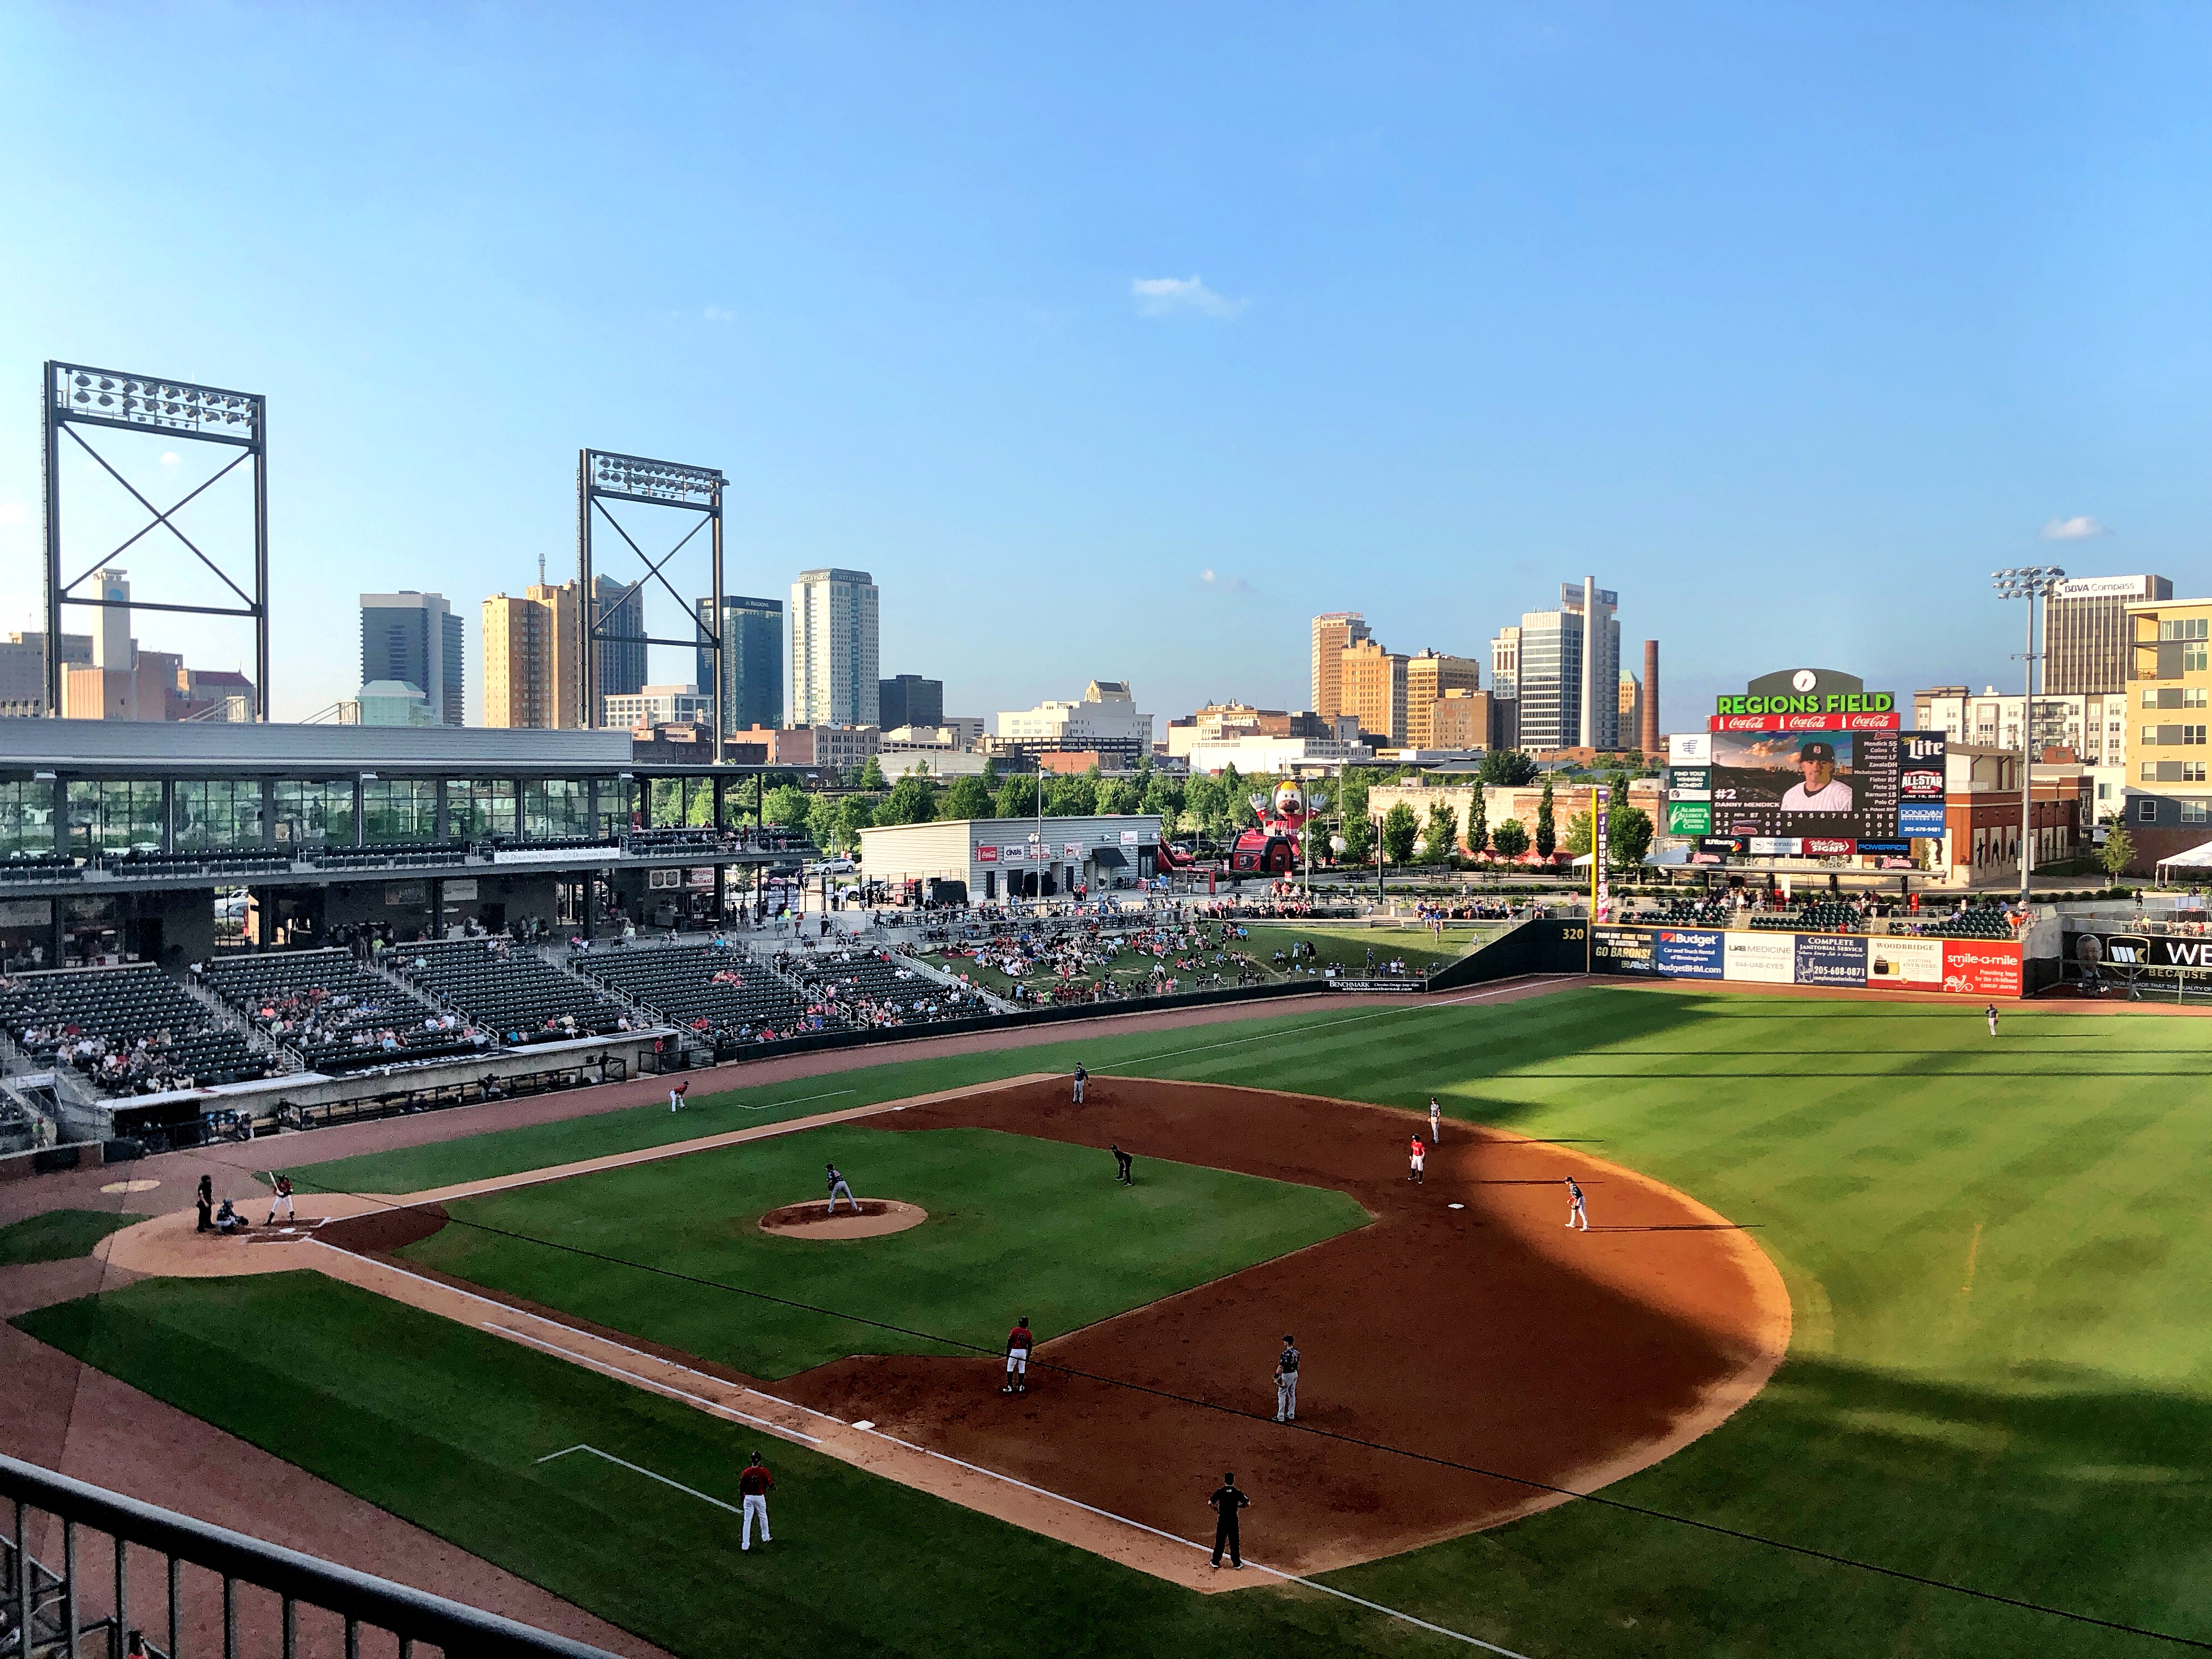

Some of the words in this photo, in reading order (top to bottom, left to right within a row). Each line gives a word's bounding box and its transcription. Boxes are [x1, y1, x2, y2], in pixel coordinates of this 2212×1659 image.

[2065, 584, 2089, 592] BBVA
[2091, 583, 2135, 591] Compass
[1718, 695, 1819, 714] REGIONS
[1827, 693, 1892, 712] FIELD
[1729, 717, 1766, 729] Coca-Cola
[1790, 716, 1828, 728] Coca-Cola
[1852, 715, 1891, 727] Coca-Cola
[1908, 740, 1944, 759] Lite
[1901, 776, 1943, 788] ALL-STAR
[1714, 788, 1737, 799] #2
[1745, 857, 1780, 867] HOME
[1563, 929, 1584, 939] 320
[1676, 934, 1716, 947] Budget
[1808, 938, 1854, 946] COMPLETE
[1596, 946, 1608, 957] GO
[1611, 947, 1651, 959] BARONS!
[1947, 953, 2018, 967] smile-a-mile
[1658, 963, 1722, 973] BudgetBHM.com
[1814, 966, 1865, 976] 205-608-0871
